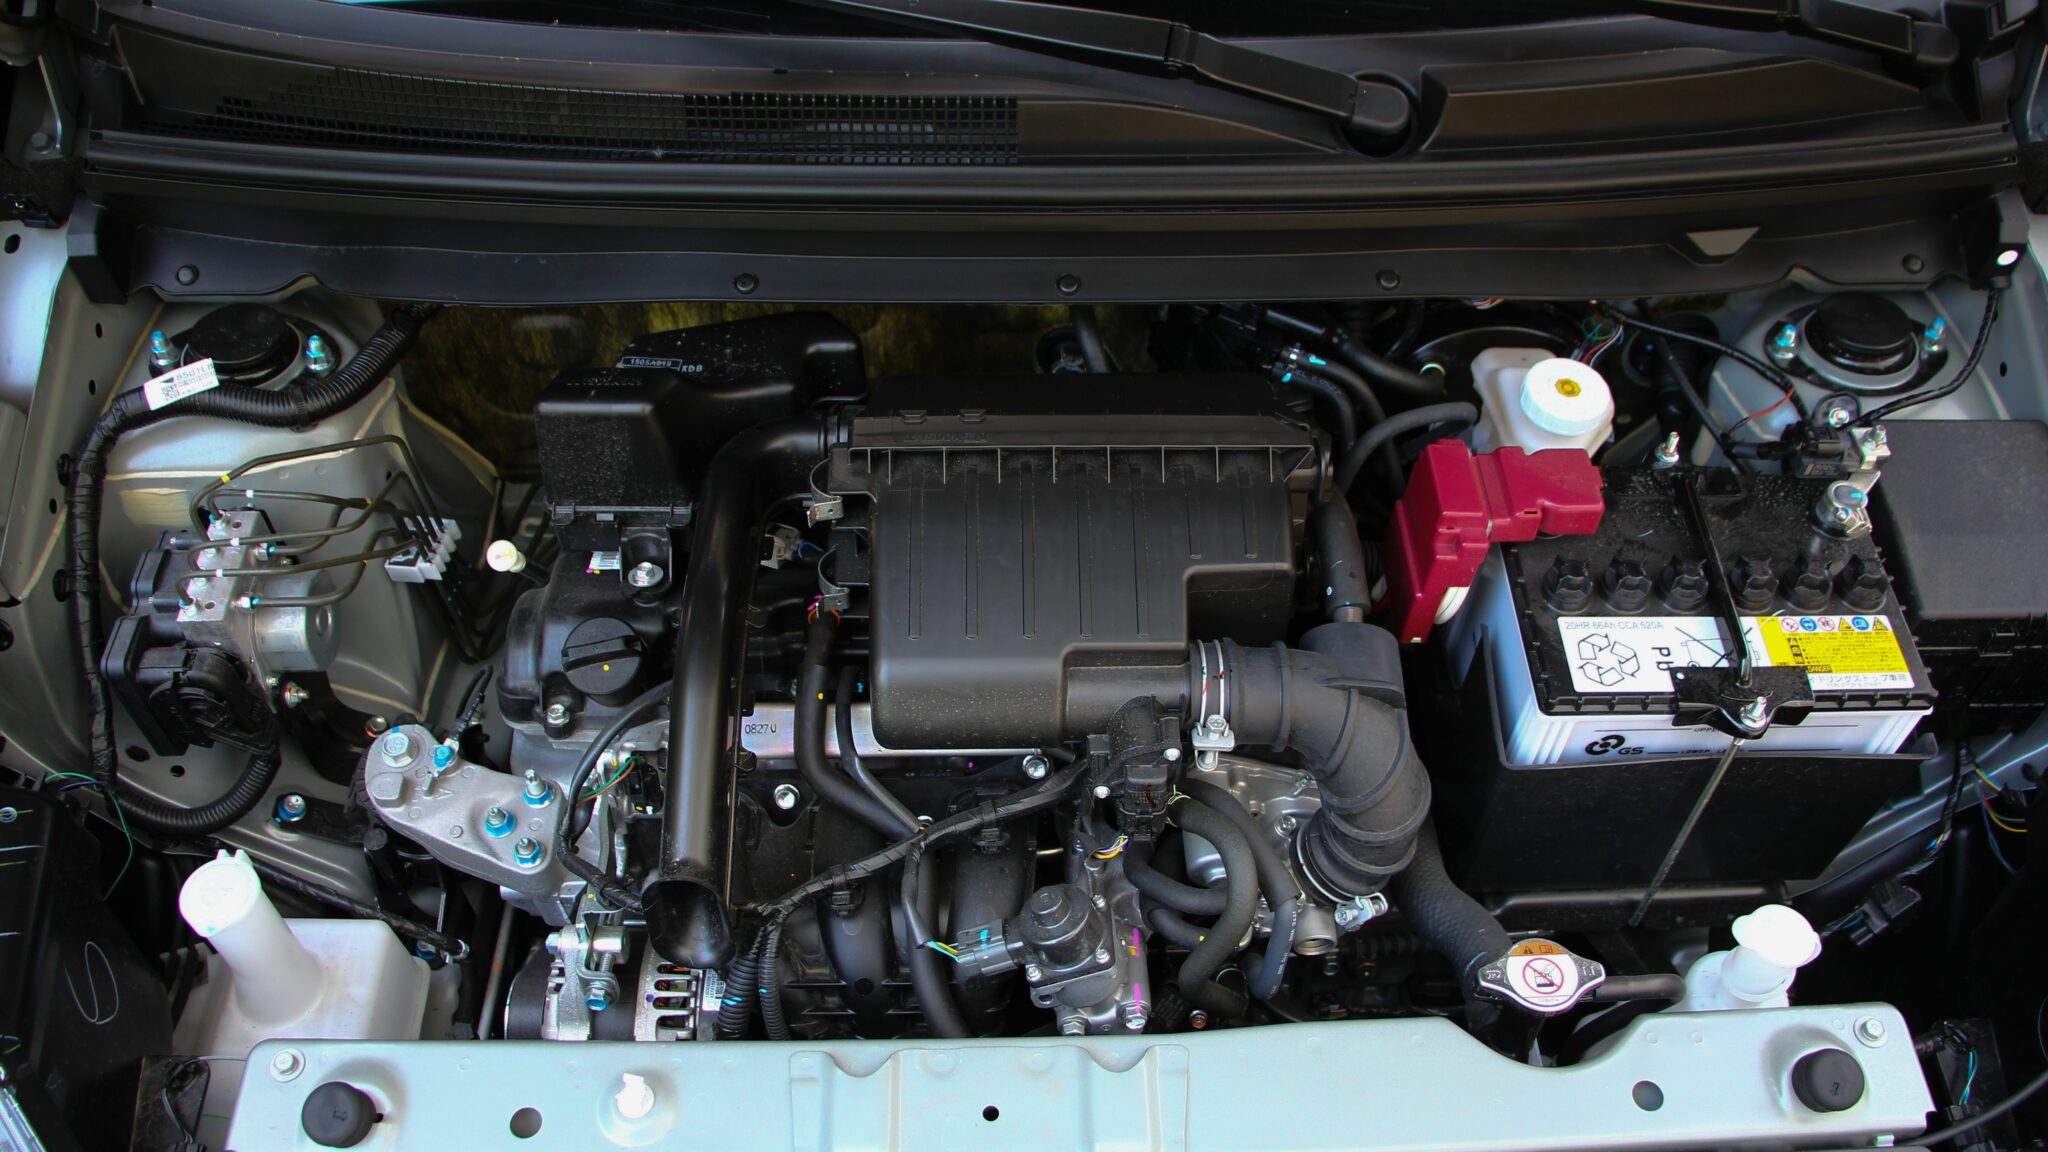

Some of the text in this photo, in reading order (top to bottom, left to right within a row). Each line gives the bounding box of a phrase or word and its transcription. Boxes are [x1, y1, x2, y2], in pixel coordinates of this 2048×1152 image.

[1640, 621, 1664, 629] 520A
[1651, 646, 1674, 671] Pb
[1617, 746, 1645, 755] GS
